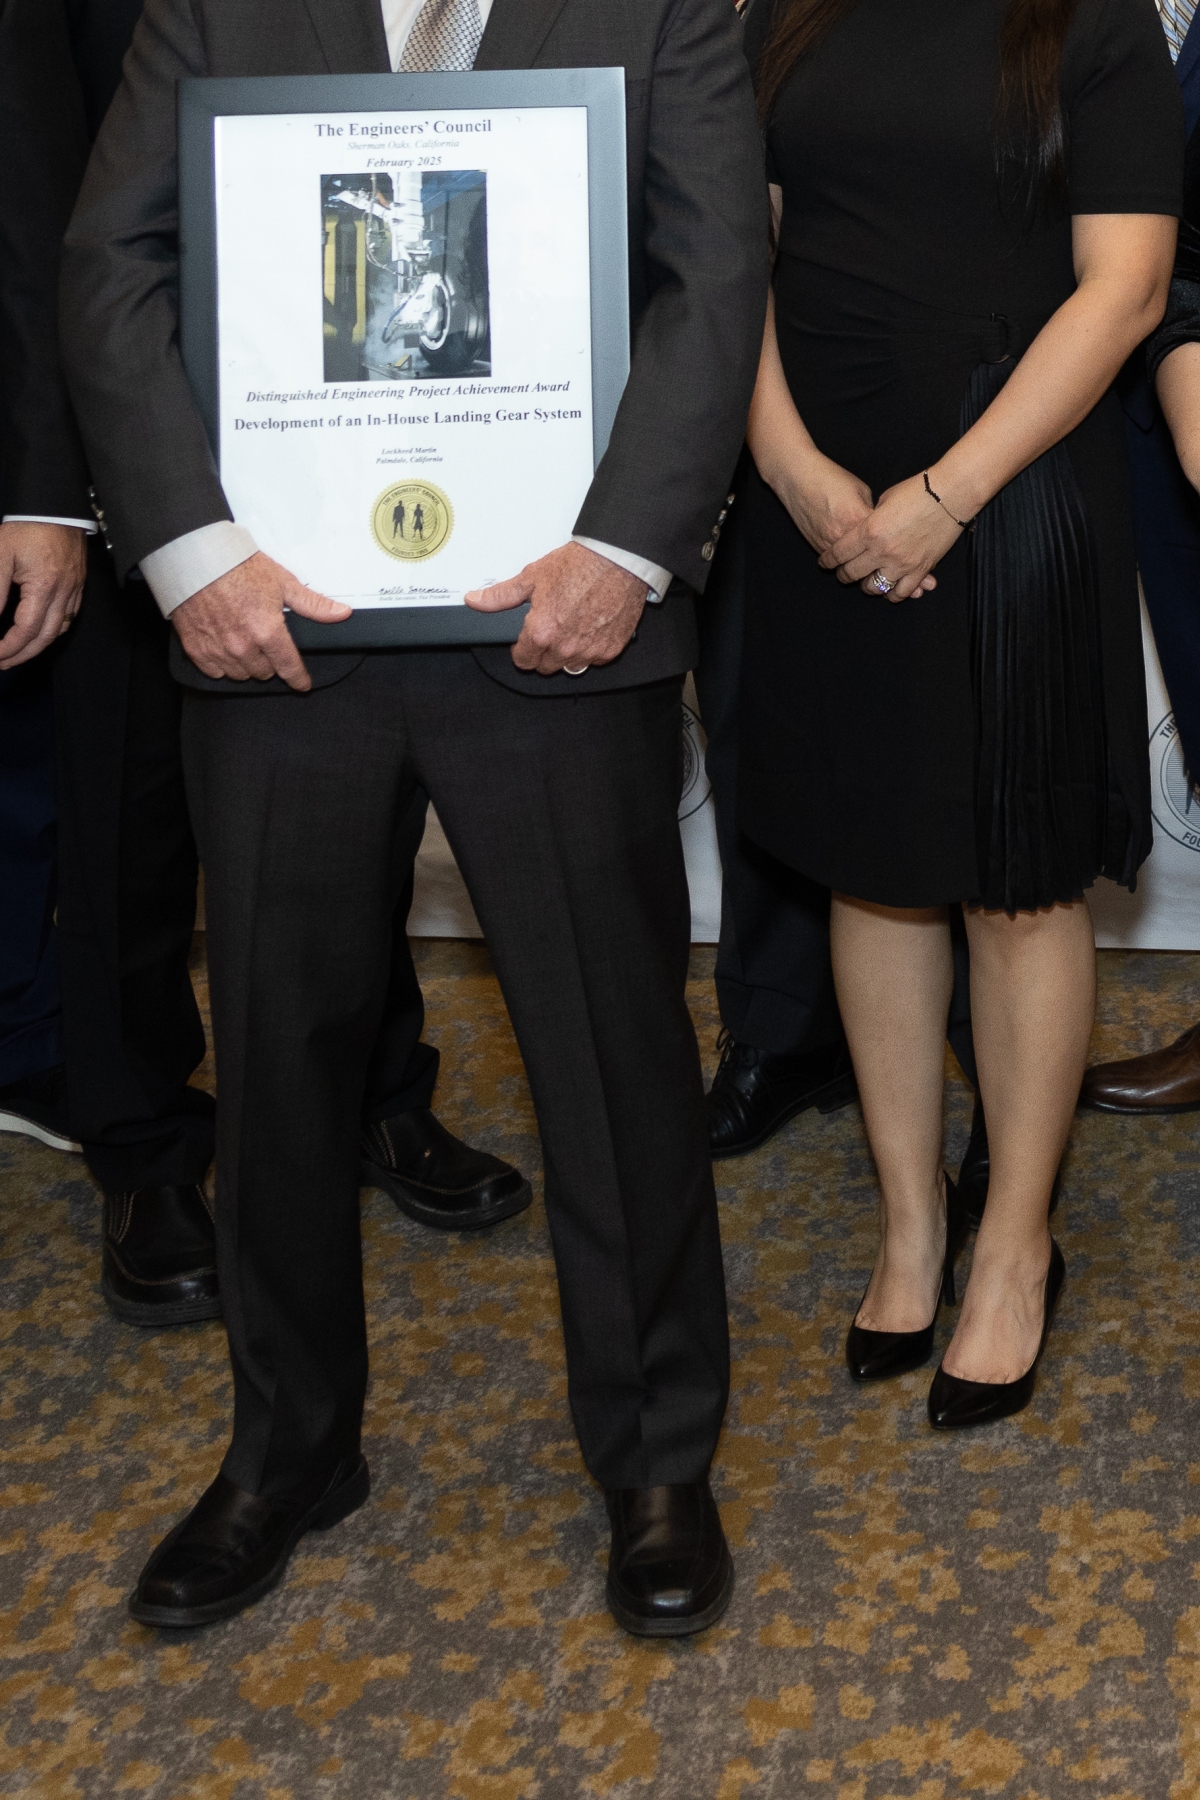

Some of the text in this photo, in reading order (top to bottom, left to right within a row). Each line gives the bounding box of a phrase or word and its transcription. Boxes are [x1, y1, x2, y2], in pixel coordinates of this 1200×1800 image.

[314, 119, 492, 138] The Engineers' Council
[347, 141, 385, 151] Sherman
[415, 139, 460, 151] California
[366, 156, 442, 169] February 2025
[246, 381, 571, 404] Distinguished Engineering Project Achievement Award
[234, 407, 582, 432] Development of an In-House Landing Gear System
[410, 456, 444, 465] California
